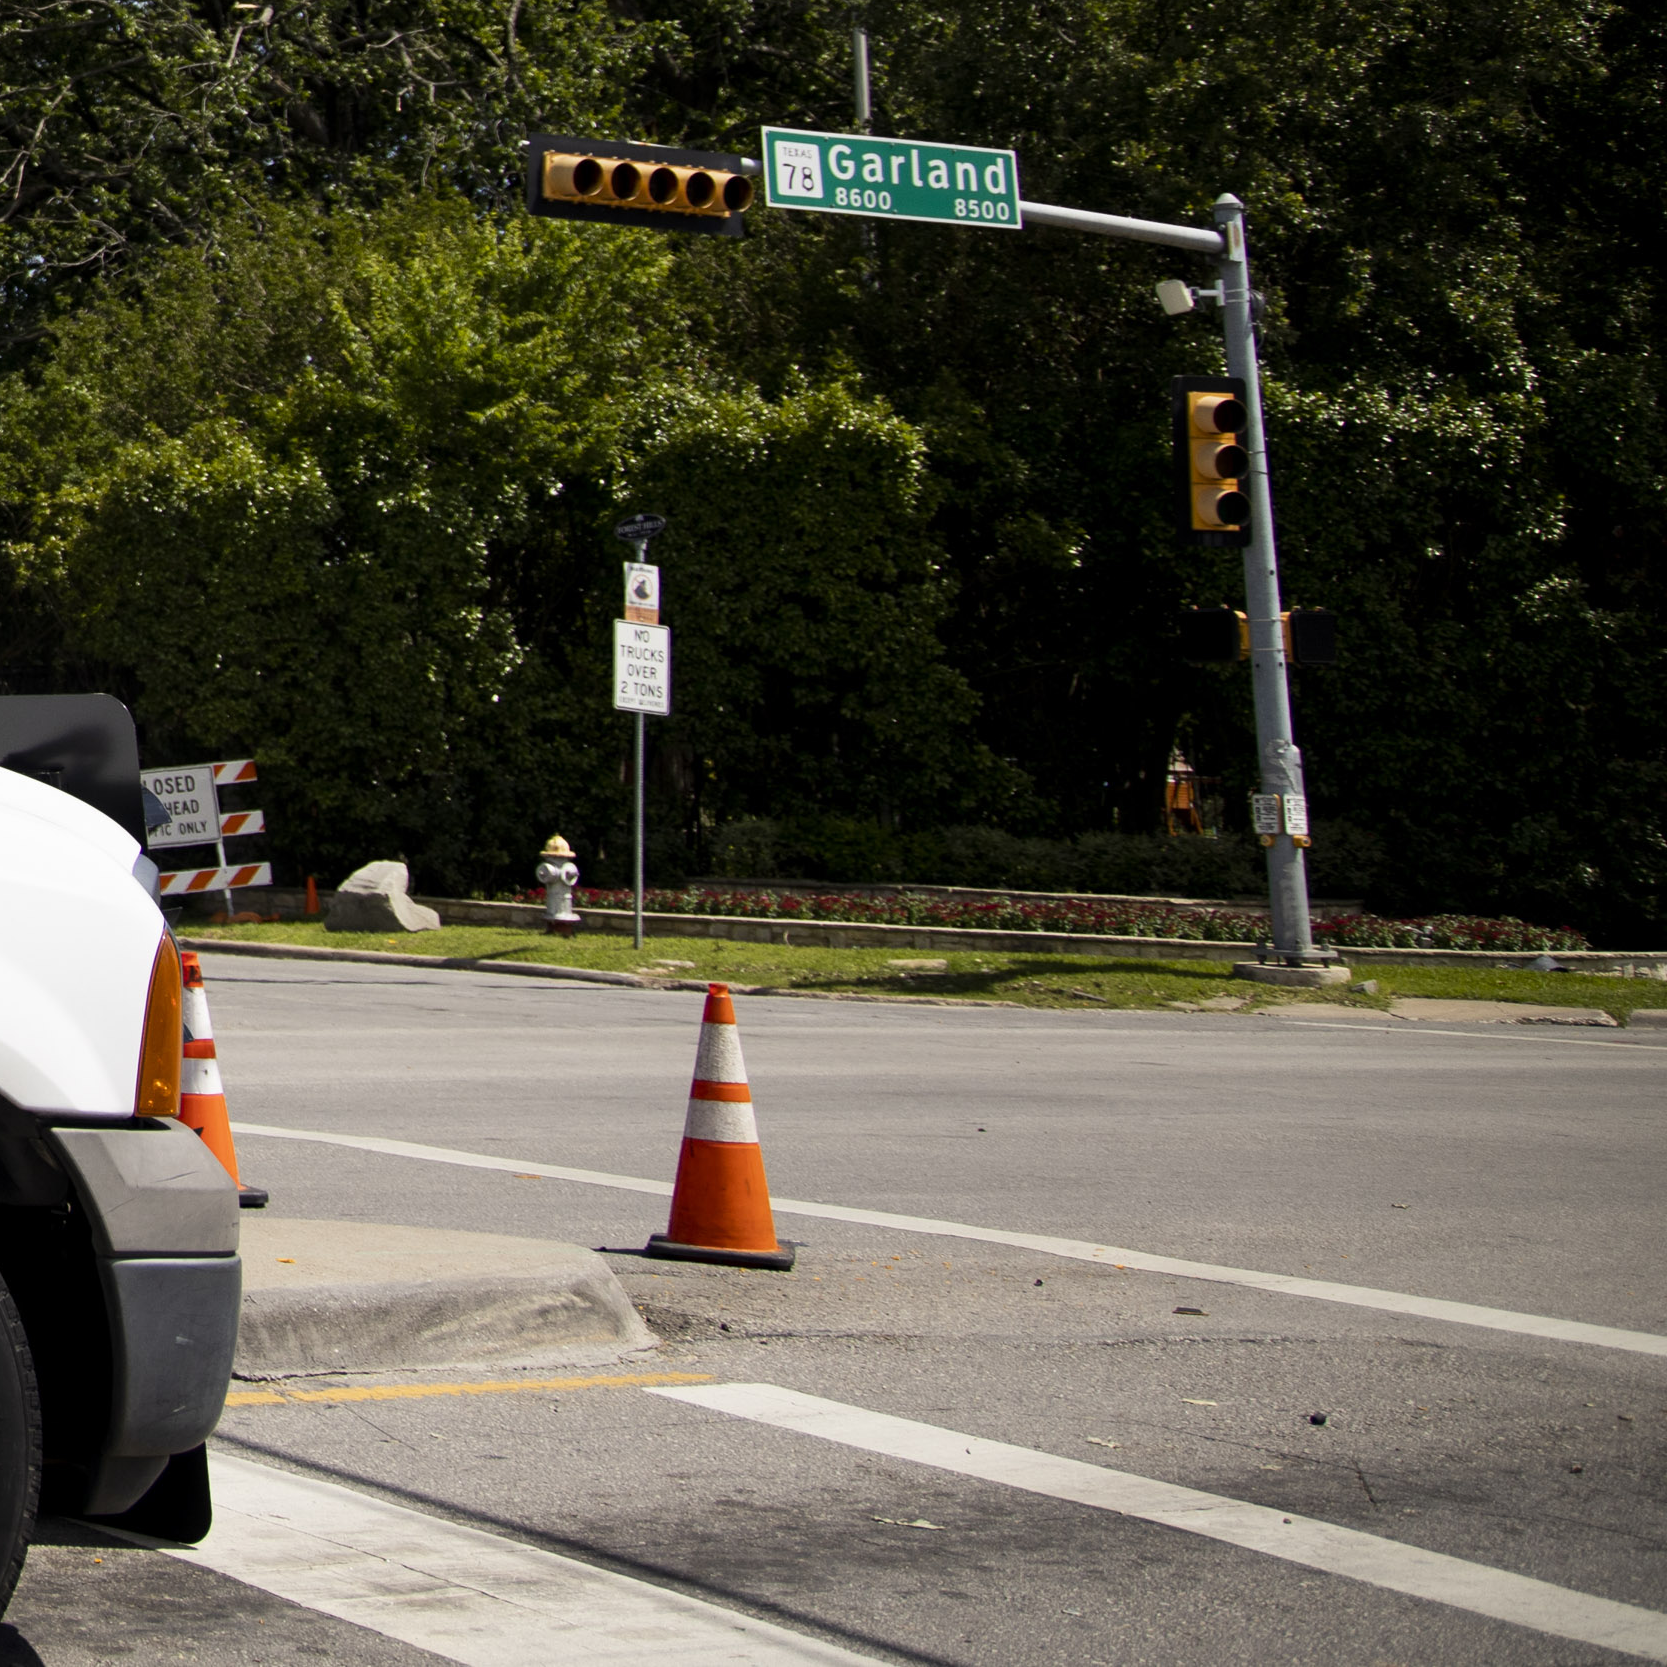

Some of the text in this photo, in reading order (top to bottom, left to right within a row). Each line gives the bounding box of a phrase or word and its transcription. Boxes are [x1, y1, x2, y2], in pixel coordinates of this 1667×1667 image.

[782, 146, 813, 159] TEXAS
[782, 163, 815, 191] 78
[827, 143, 1007, 195] Garland
[835, 187, 892, 210] 8600
[954, 198, 1010, 220] 8500
[634, 629, 650, 643] NO
[620, 644, 664, 663] TRUCKS
[627, 663, 657, 679] OVER
[621, 680, 663, 698] 2 TONS
[144, 775, 195, 795] OSED
[165, 799, 199, 816] HEAD
[179, 821, 208, 835] ONLY
